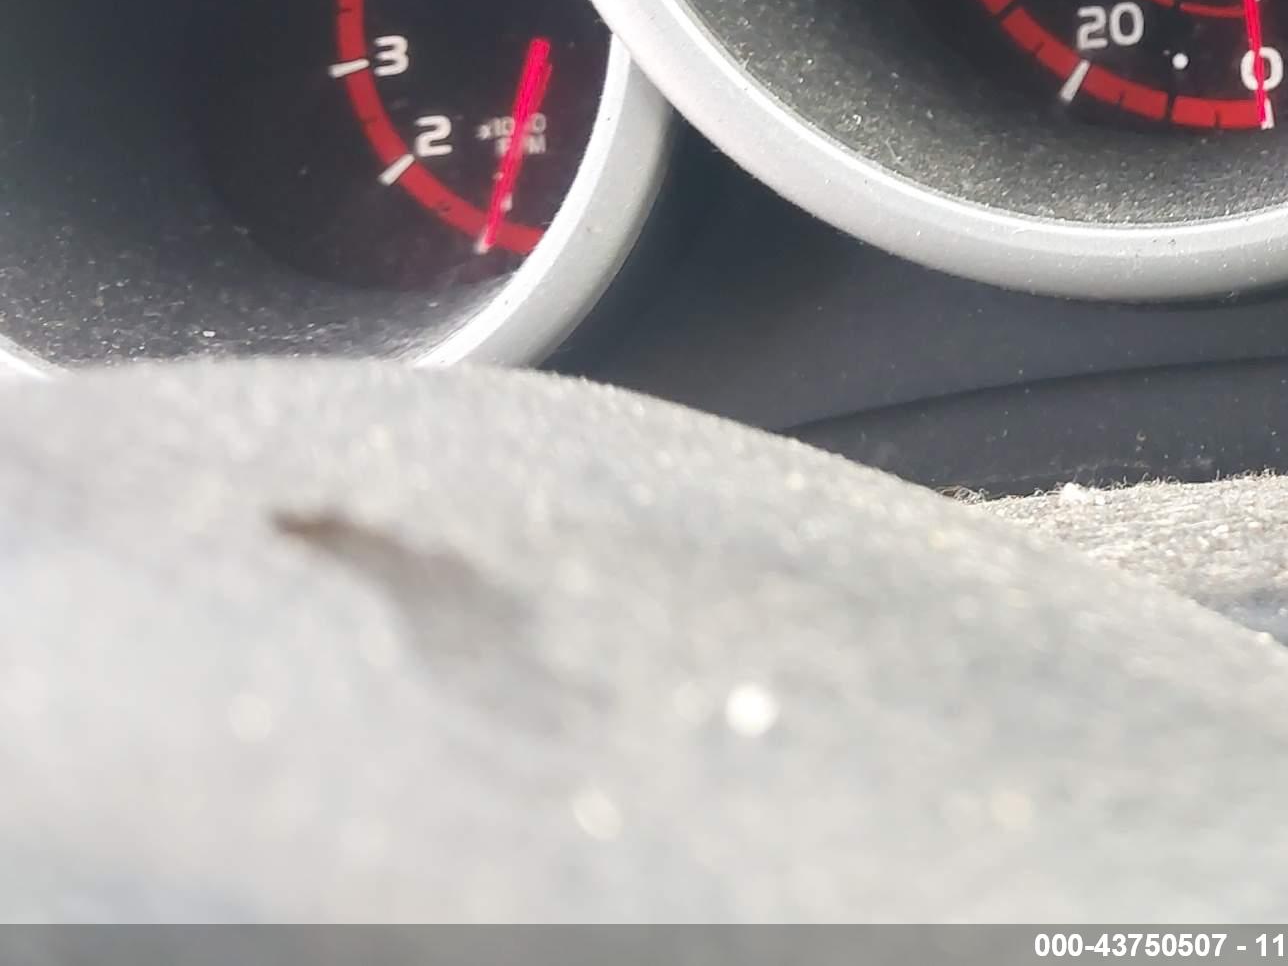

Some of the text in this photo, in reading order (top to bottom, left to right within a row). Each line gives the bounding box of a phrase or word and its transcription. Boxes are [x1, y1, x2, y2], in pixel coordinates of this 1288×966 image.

[1076, 1, 1144, 50] 20
[374, 34, 410, 76] 3
[1240, 46, 1284, 91] 0
[415, 114, 453, 157] 2
